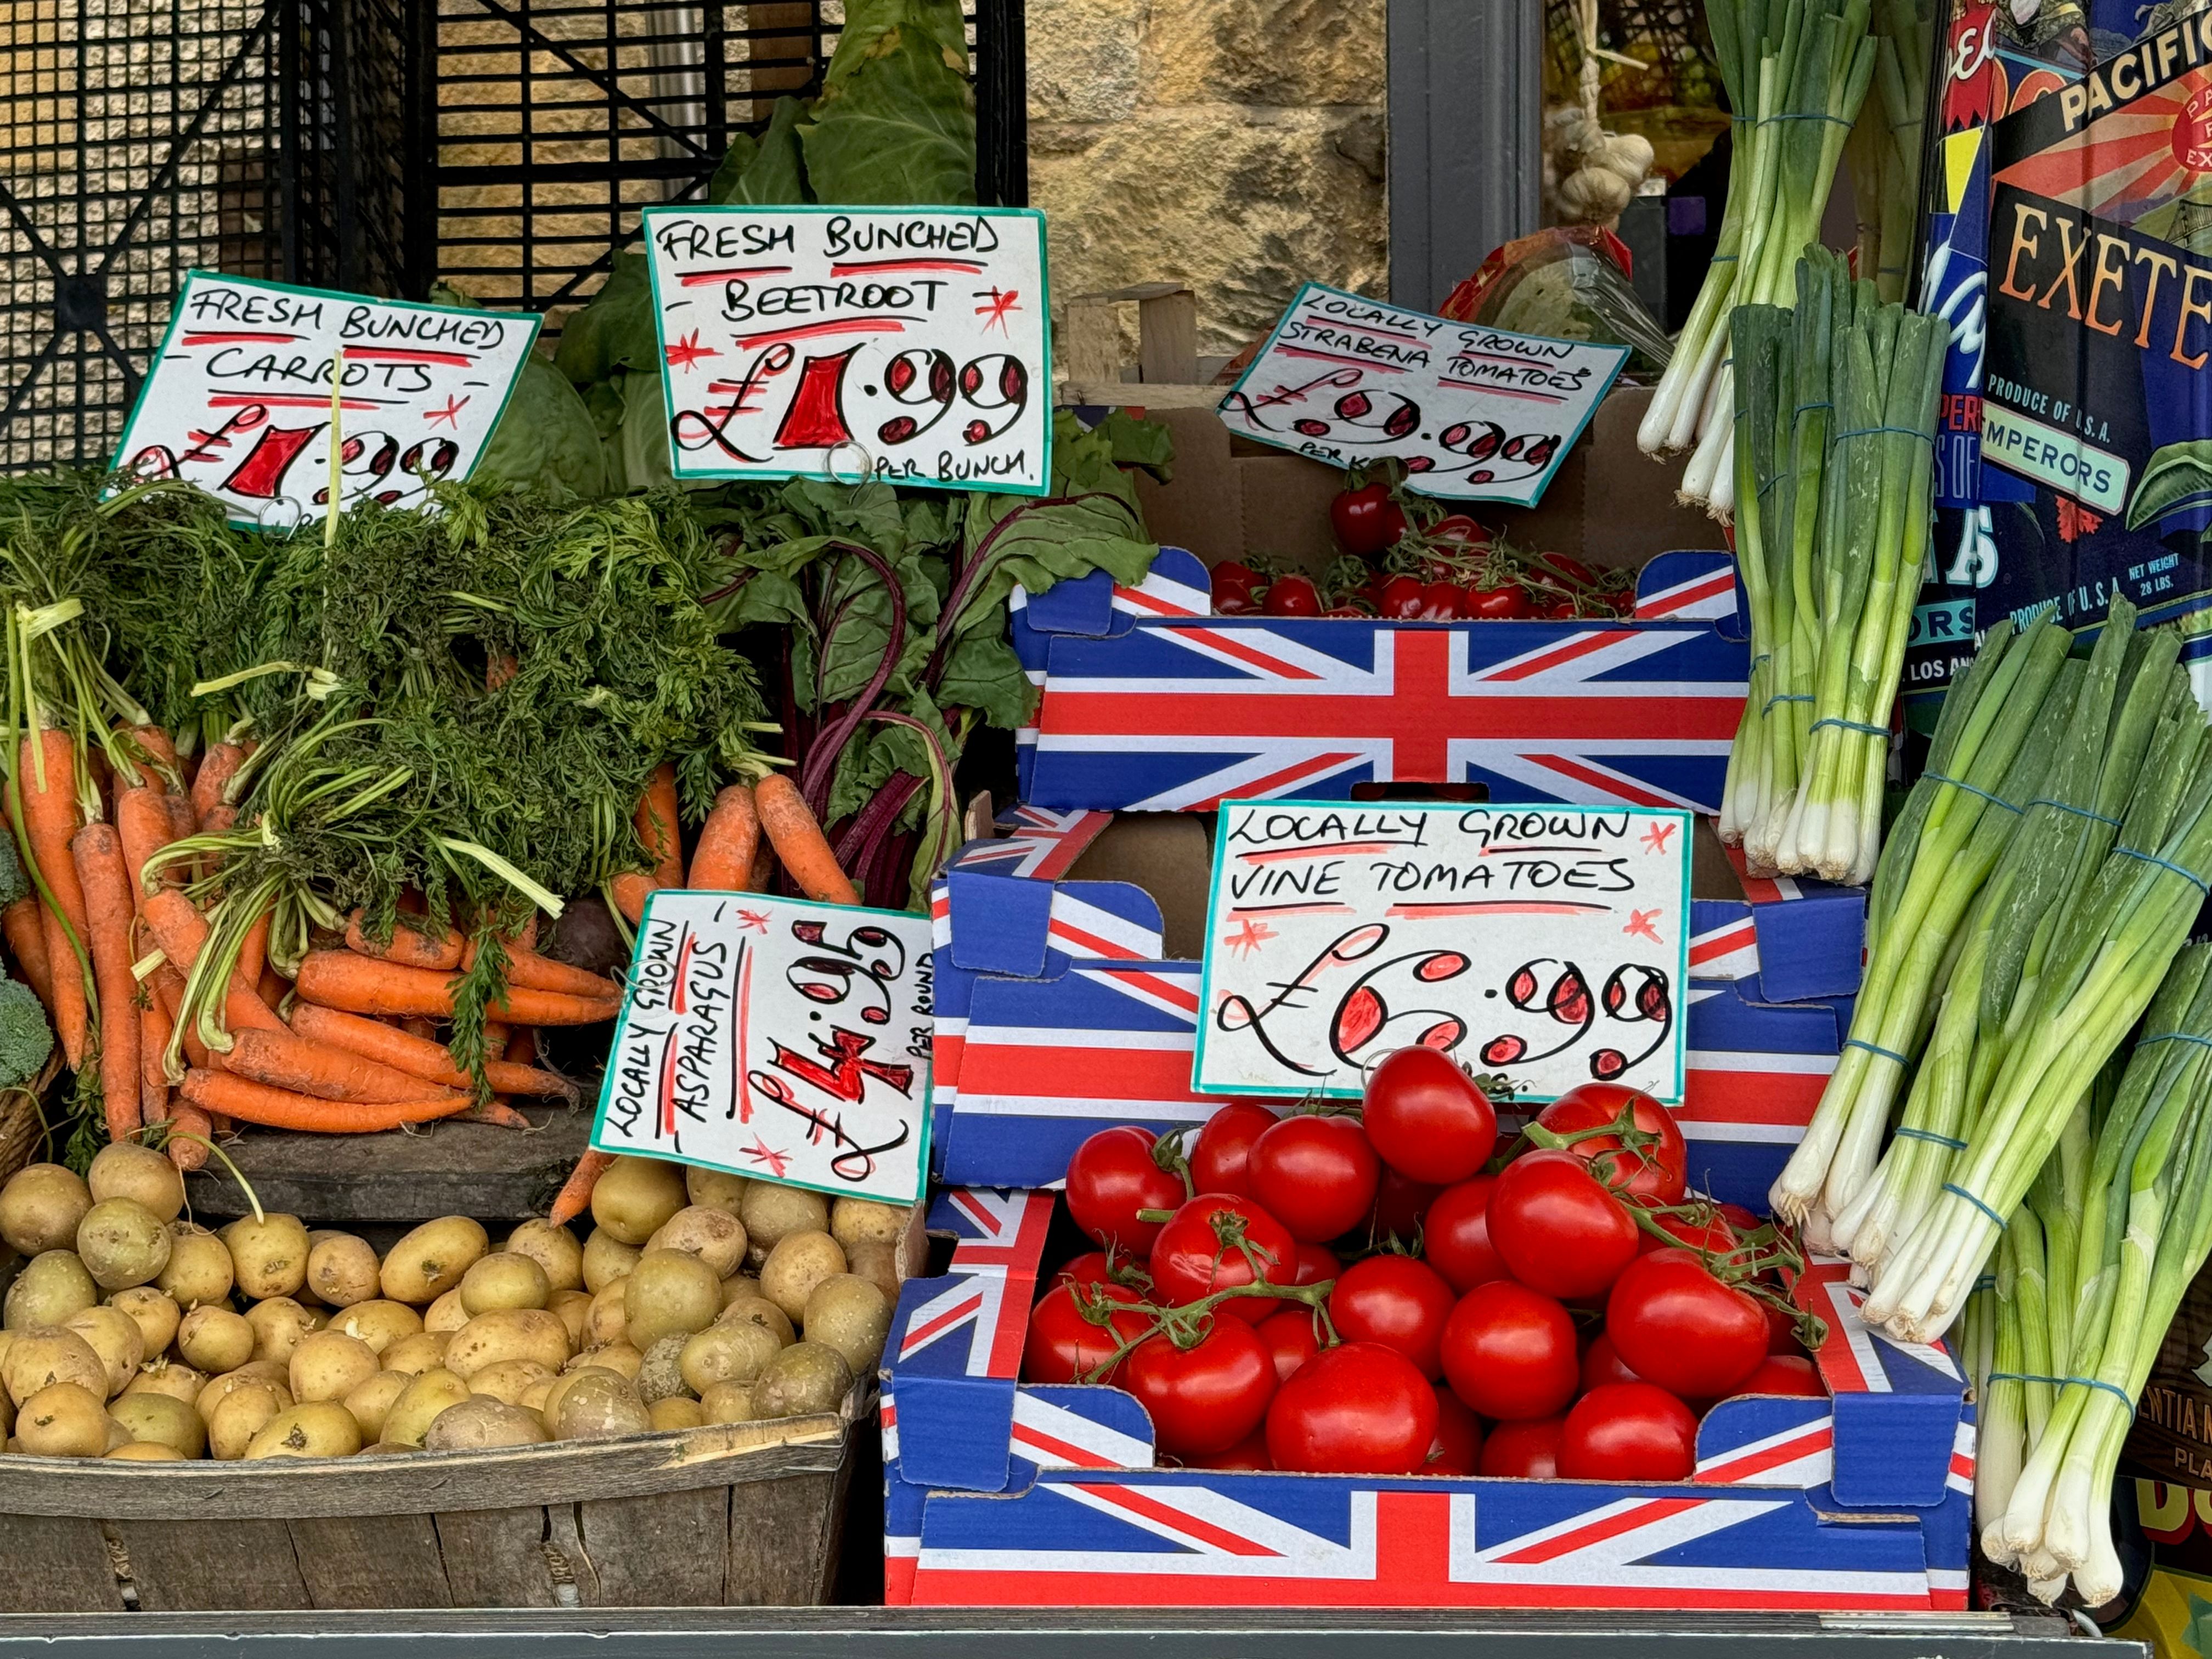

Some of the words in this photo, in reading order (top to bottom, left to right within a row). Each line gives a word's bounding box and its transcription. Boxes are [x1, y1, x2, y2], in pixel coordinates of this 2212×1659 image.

[657, 220, 794, 262] FRESH
[823, 215, 998, 257] BUNCHED
[190, 289, 324, 330] FRESH
[339, 306, 504, 350] BUNCHED
[721, 279, 949, 321] BEETROOT
[1302, 295, 1442, 336] LOCALLY
[1458, 331, 1574, 359] GROWN
[206, 348, 432, 392] CARROTS
[1278, 321, 1430, 367] STRABENA
[1447, 356, 1592, 391] TOMATOES
[670, 342, 1028, 463] £1.99
[1988, 373, 2048, 415] PRODUCE
[2053, 400, 2071, 422] OF
[877, 456, 925, 480] PER
[1299, 442, 1344, 462] PER
[1348, 455, 1371, 471] K
[1981, 416, 2111, 494] MPERORS
[2129, 563, 2145, 581] NET
[2147, 553, 2179, 574] WEIGHT
[2140, 581, 2152, 597] 28
[1911, 659, 1944, 681] LOS
[1228, 809, 1428, 846] LOCALLY
[1459, 809, 1630, 848] GROWN
[1231, 860, 1345, 900] VINE
[1370, 858, 1635, 893] TOMATOES
[631, 918, 678, 1010] GROWN
[910, 953, 934, 1017] ROUND
[1216, 923, 1673, 1081] £6.99
[670, 940, 731, 1123] ASPARAGUS
[748, 920, 915, 1183] £4.95
[906, 1027, 932, 1060] PER
[606, 1023, 667, 1137] LOCALLY
